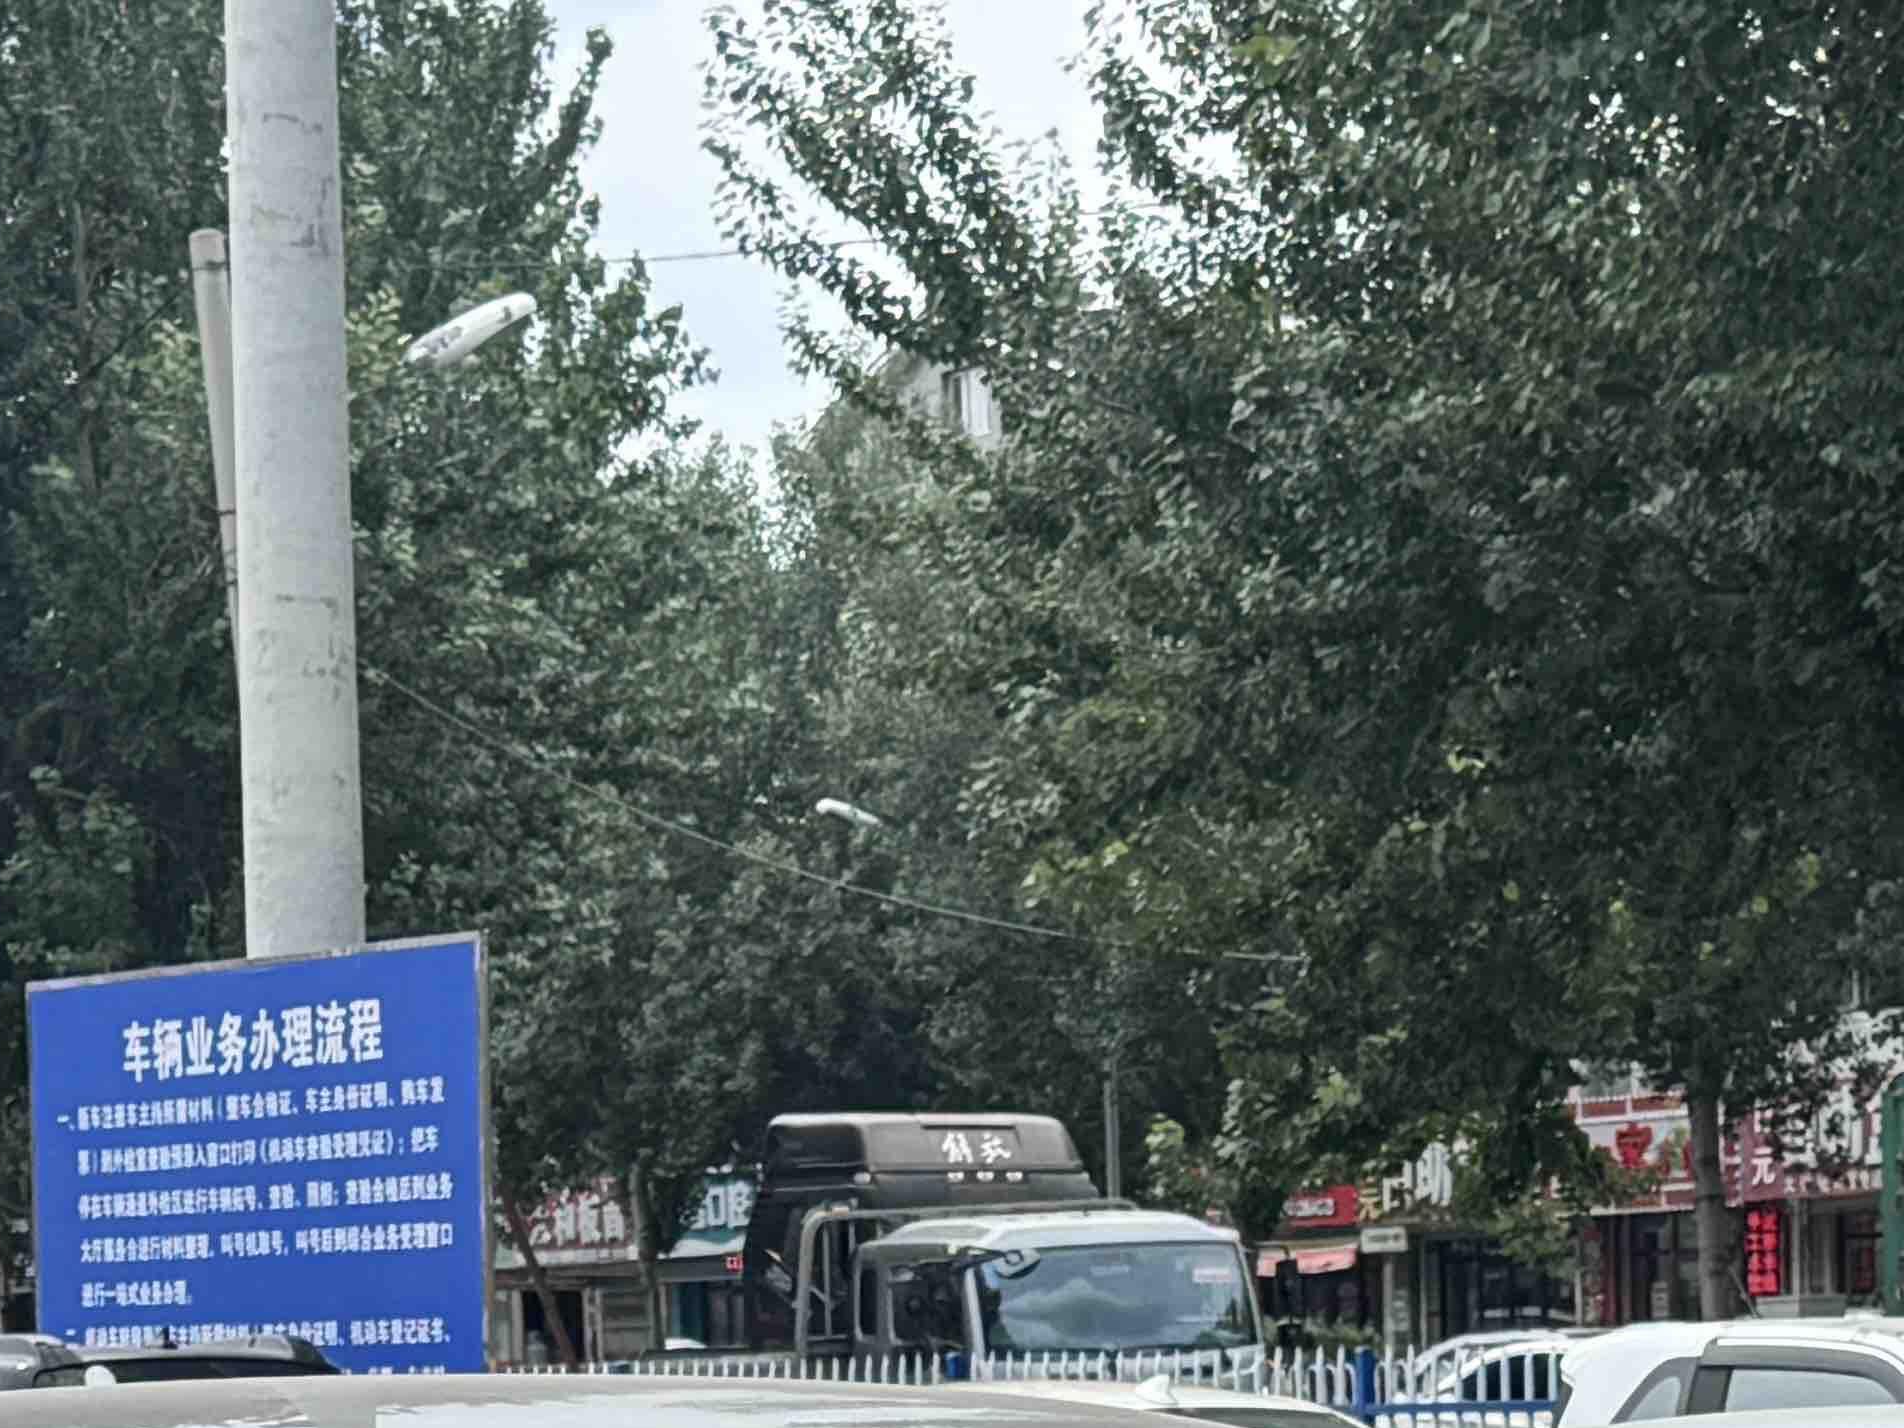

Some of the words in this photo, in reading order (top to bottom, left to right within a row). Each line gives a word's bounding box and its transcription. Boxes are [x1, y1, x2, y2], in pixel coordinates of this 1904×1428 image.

[122, 998, 385, 1083] 车辆业务办理流程
